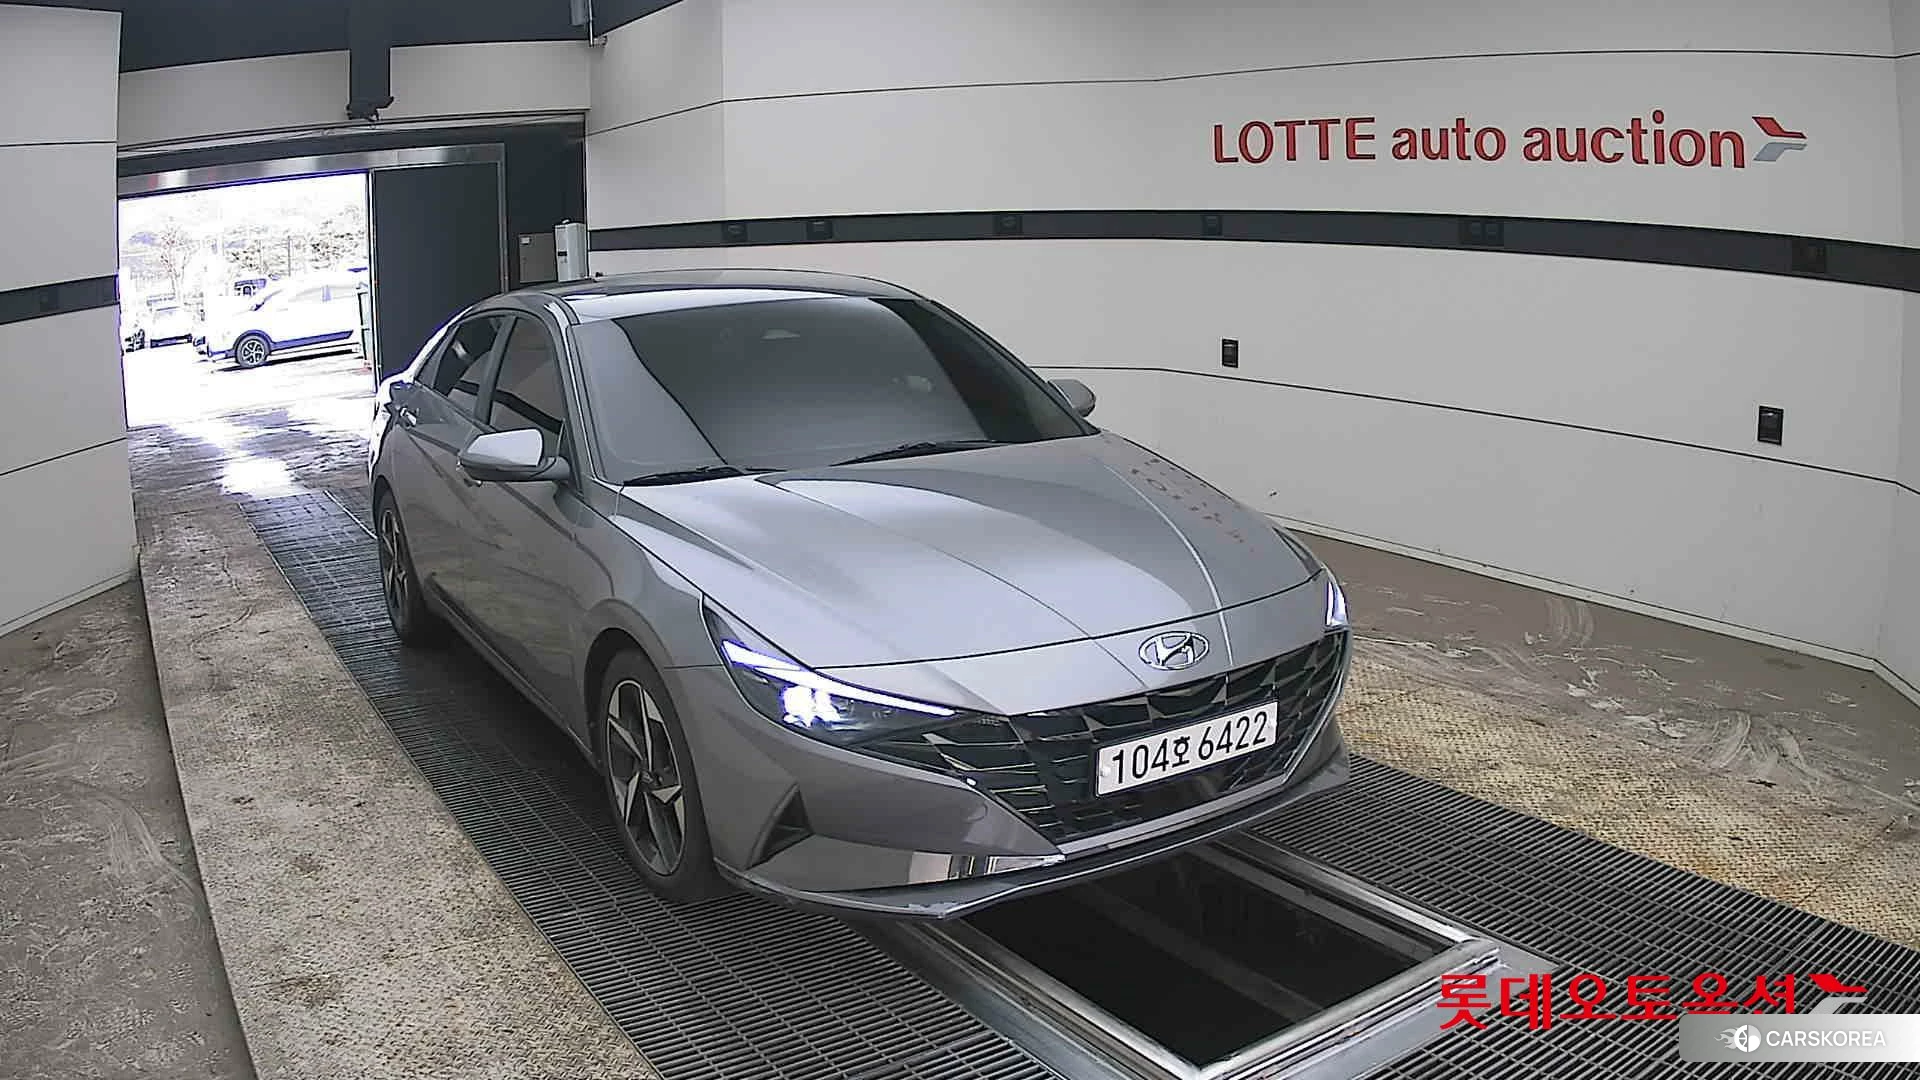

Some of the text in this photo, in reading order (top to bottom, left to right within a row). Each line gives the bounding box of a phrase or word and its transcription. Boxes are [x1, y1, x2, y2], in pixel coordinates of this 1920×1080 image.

[1214, 110, 1746, 169] LOTTE auto auction
[1112, 711, 1268, 785] 104호 6422
